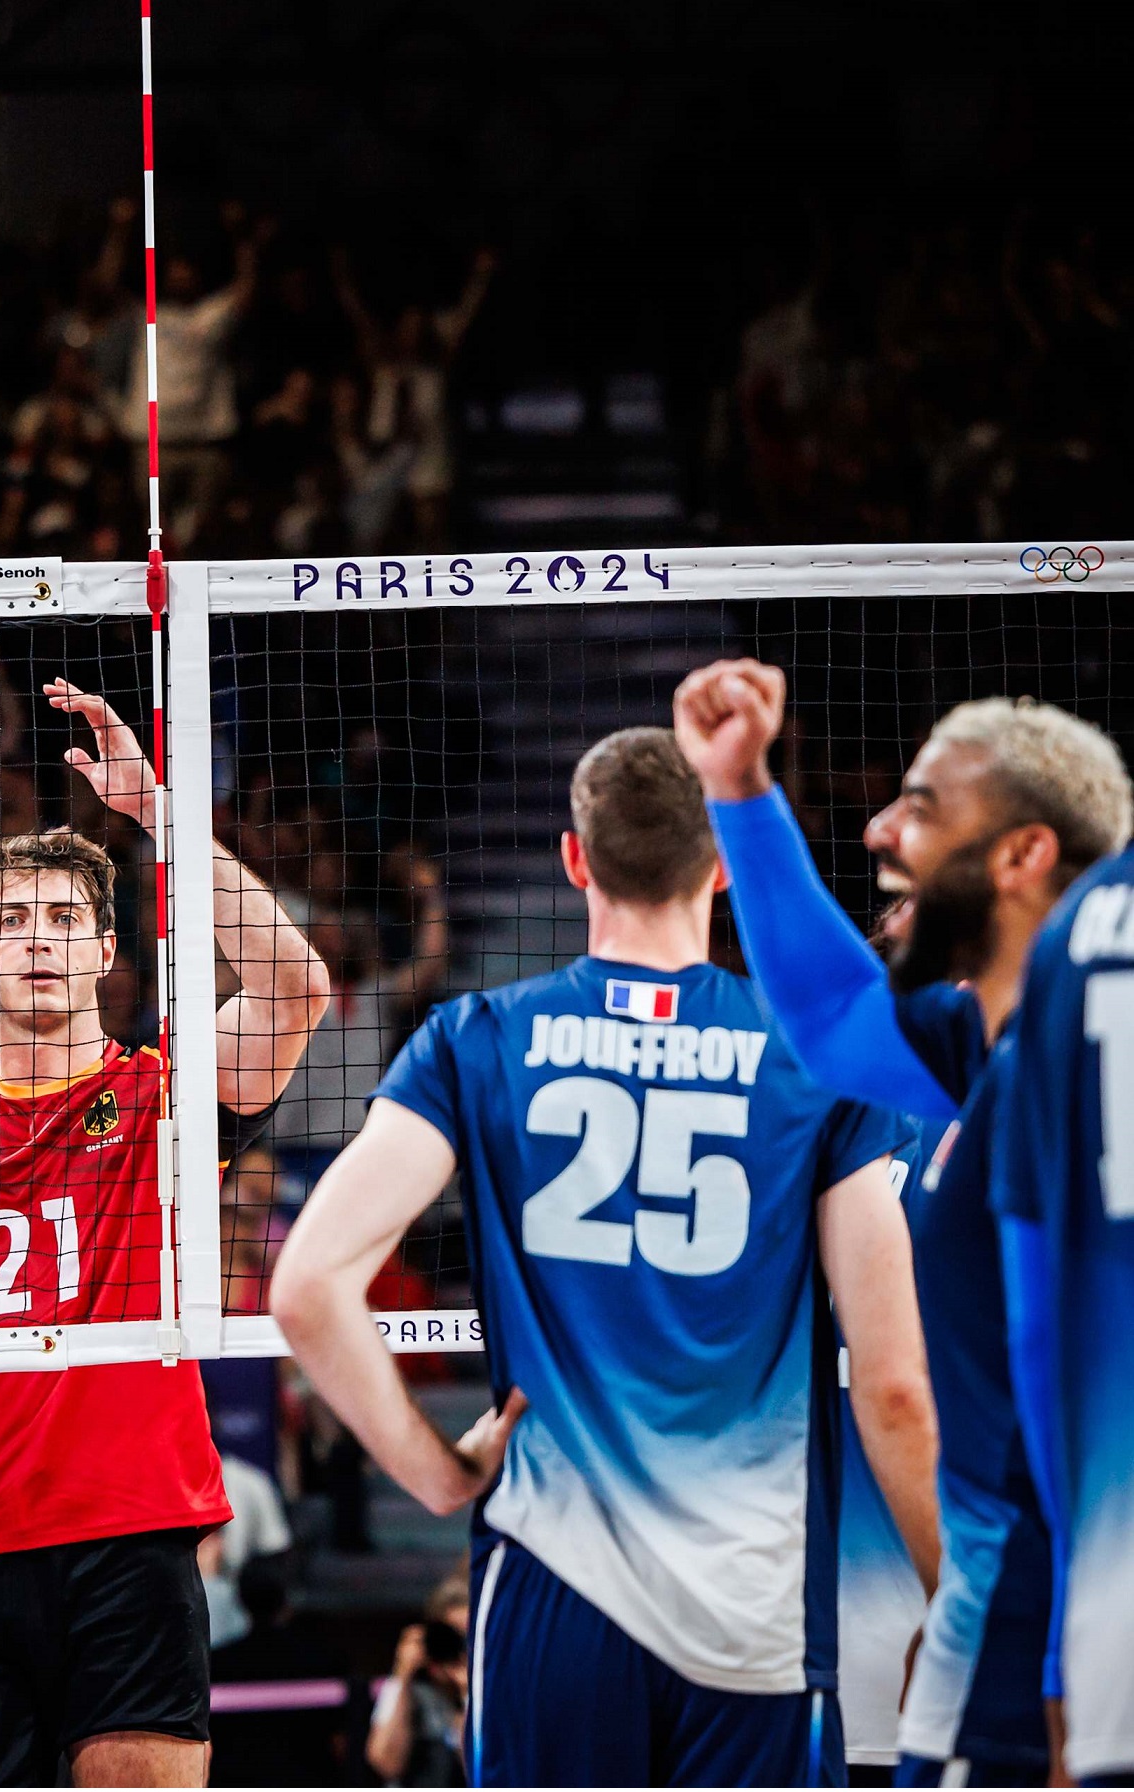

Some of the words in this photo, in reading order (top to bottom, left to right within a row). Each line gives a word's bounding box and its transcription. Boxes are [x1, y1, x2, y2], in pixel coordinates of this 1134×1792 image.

[504, 552, 669, 595] 2024
[524, 1014, 767, 1086] JOUFFROY
[522, 1075, 751, 1276] 25
